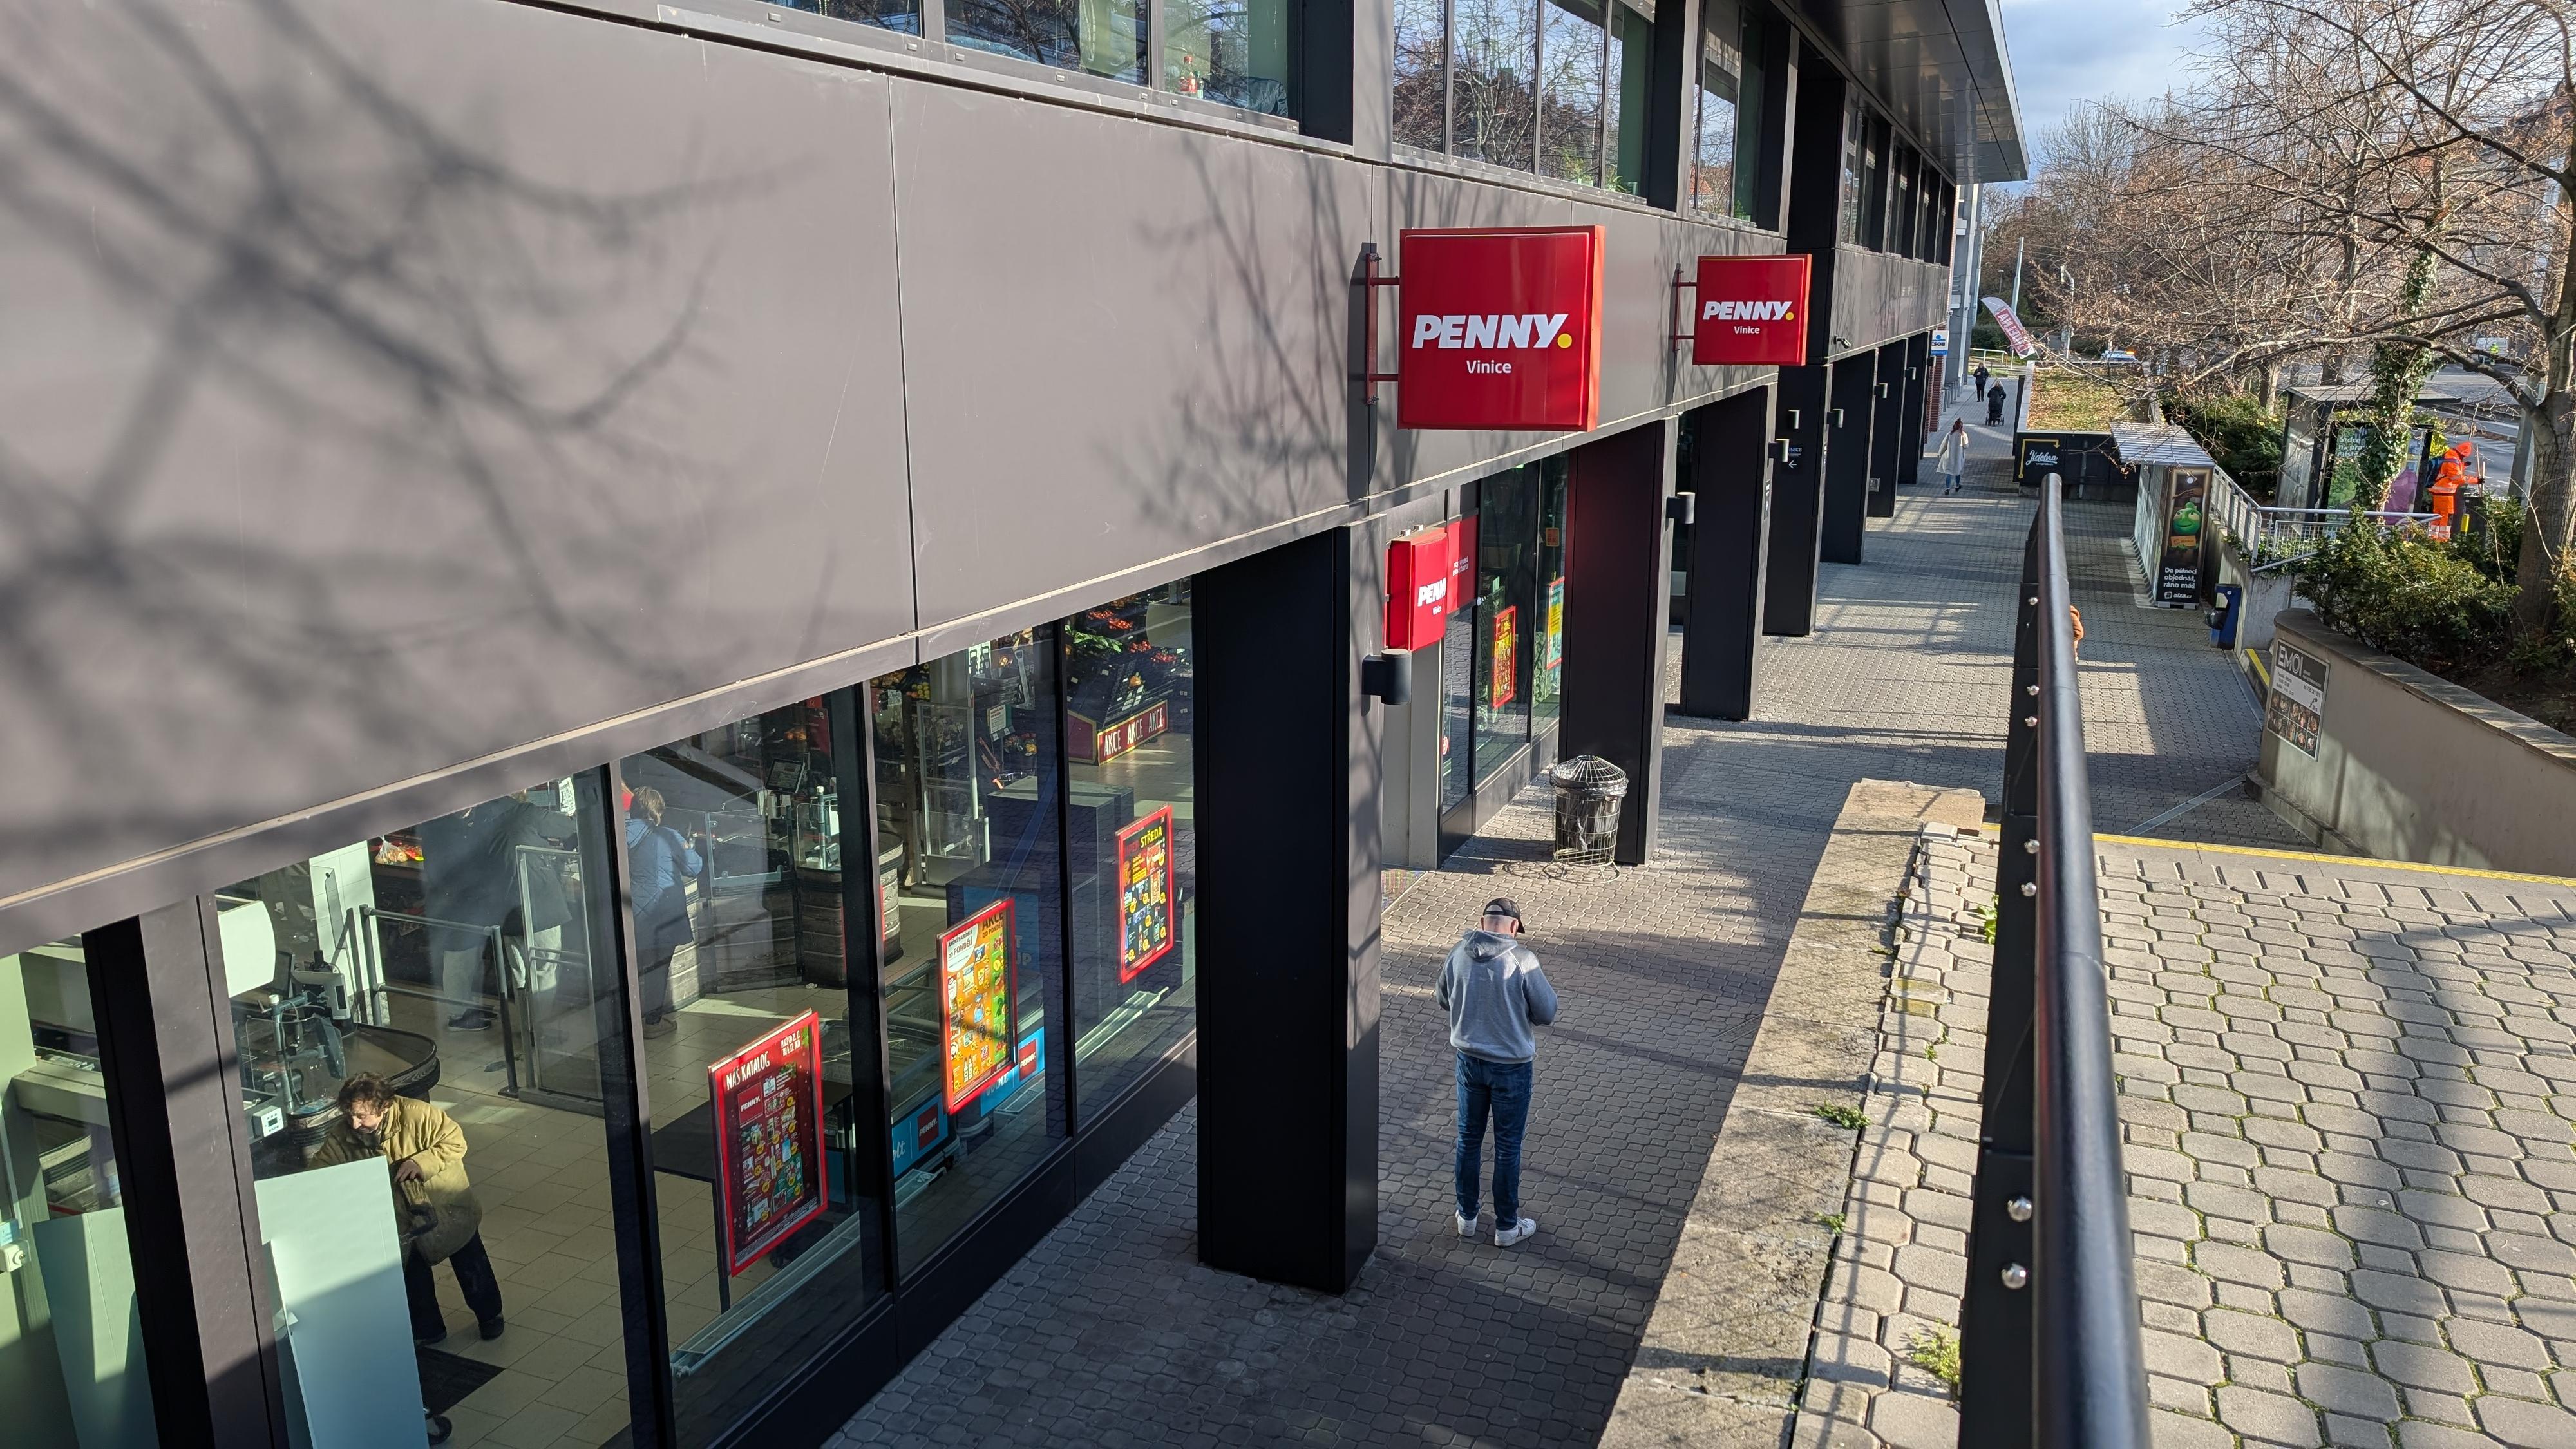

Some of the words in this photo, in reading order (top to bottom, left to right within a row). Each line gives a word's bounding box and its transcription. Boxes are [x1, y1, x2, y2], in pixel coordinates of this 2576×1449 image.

[1734, 326, 1760, 334] Vinice
[1466, 359, 1512, 374] Vinice
[1417, 577, 1446, 607] PENN
[1104, 730, 1121, 757] AKCE
[1127, 718, 1143, 745] AKCE
[1148, 707, 1163, 733] AKCE
[1141, 826, 1162, 848] STŘEDA
[954, 937, 973, 955] PONDĚLÍ
[726, 1066, 741, 1091] NÁŠ
[741, 1051, 770, 1082] KATALOG
